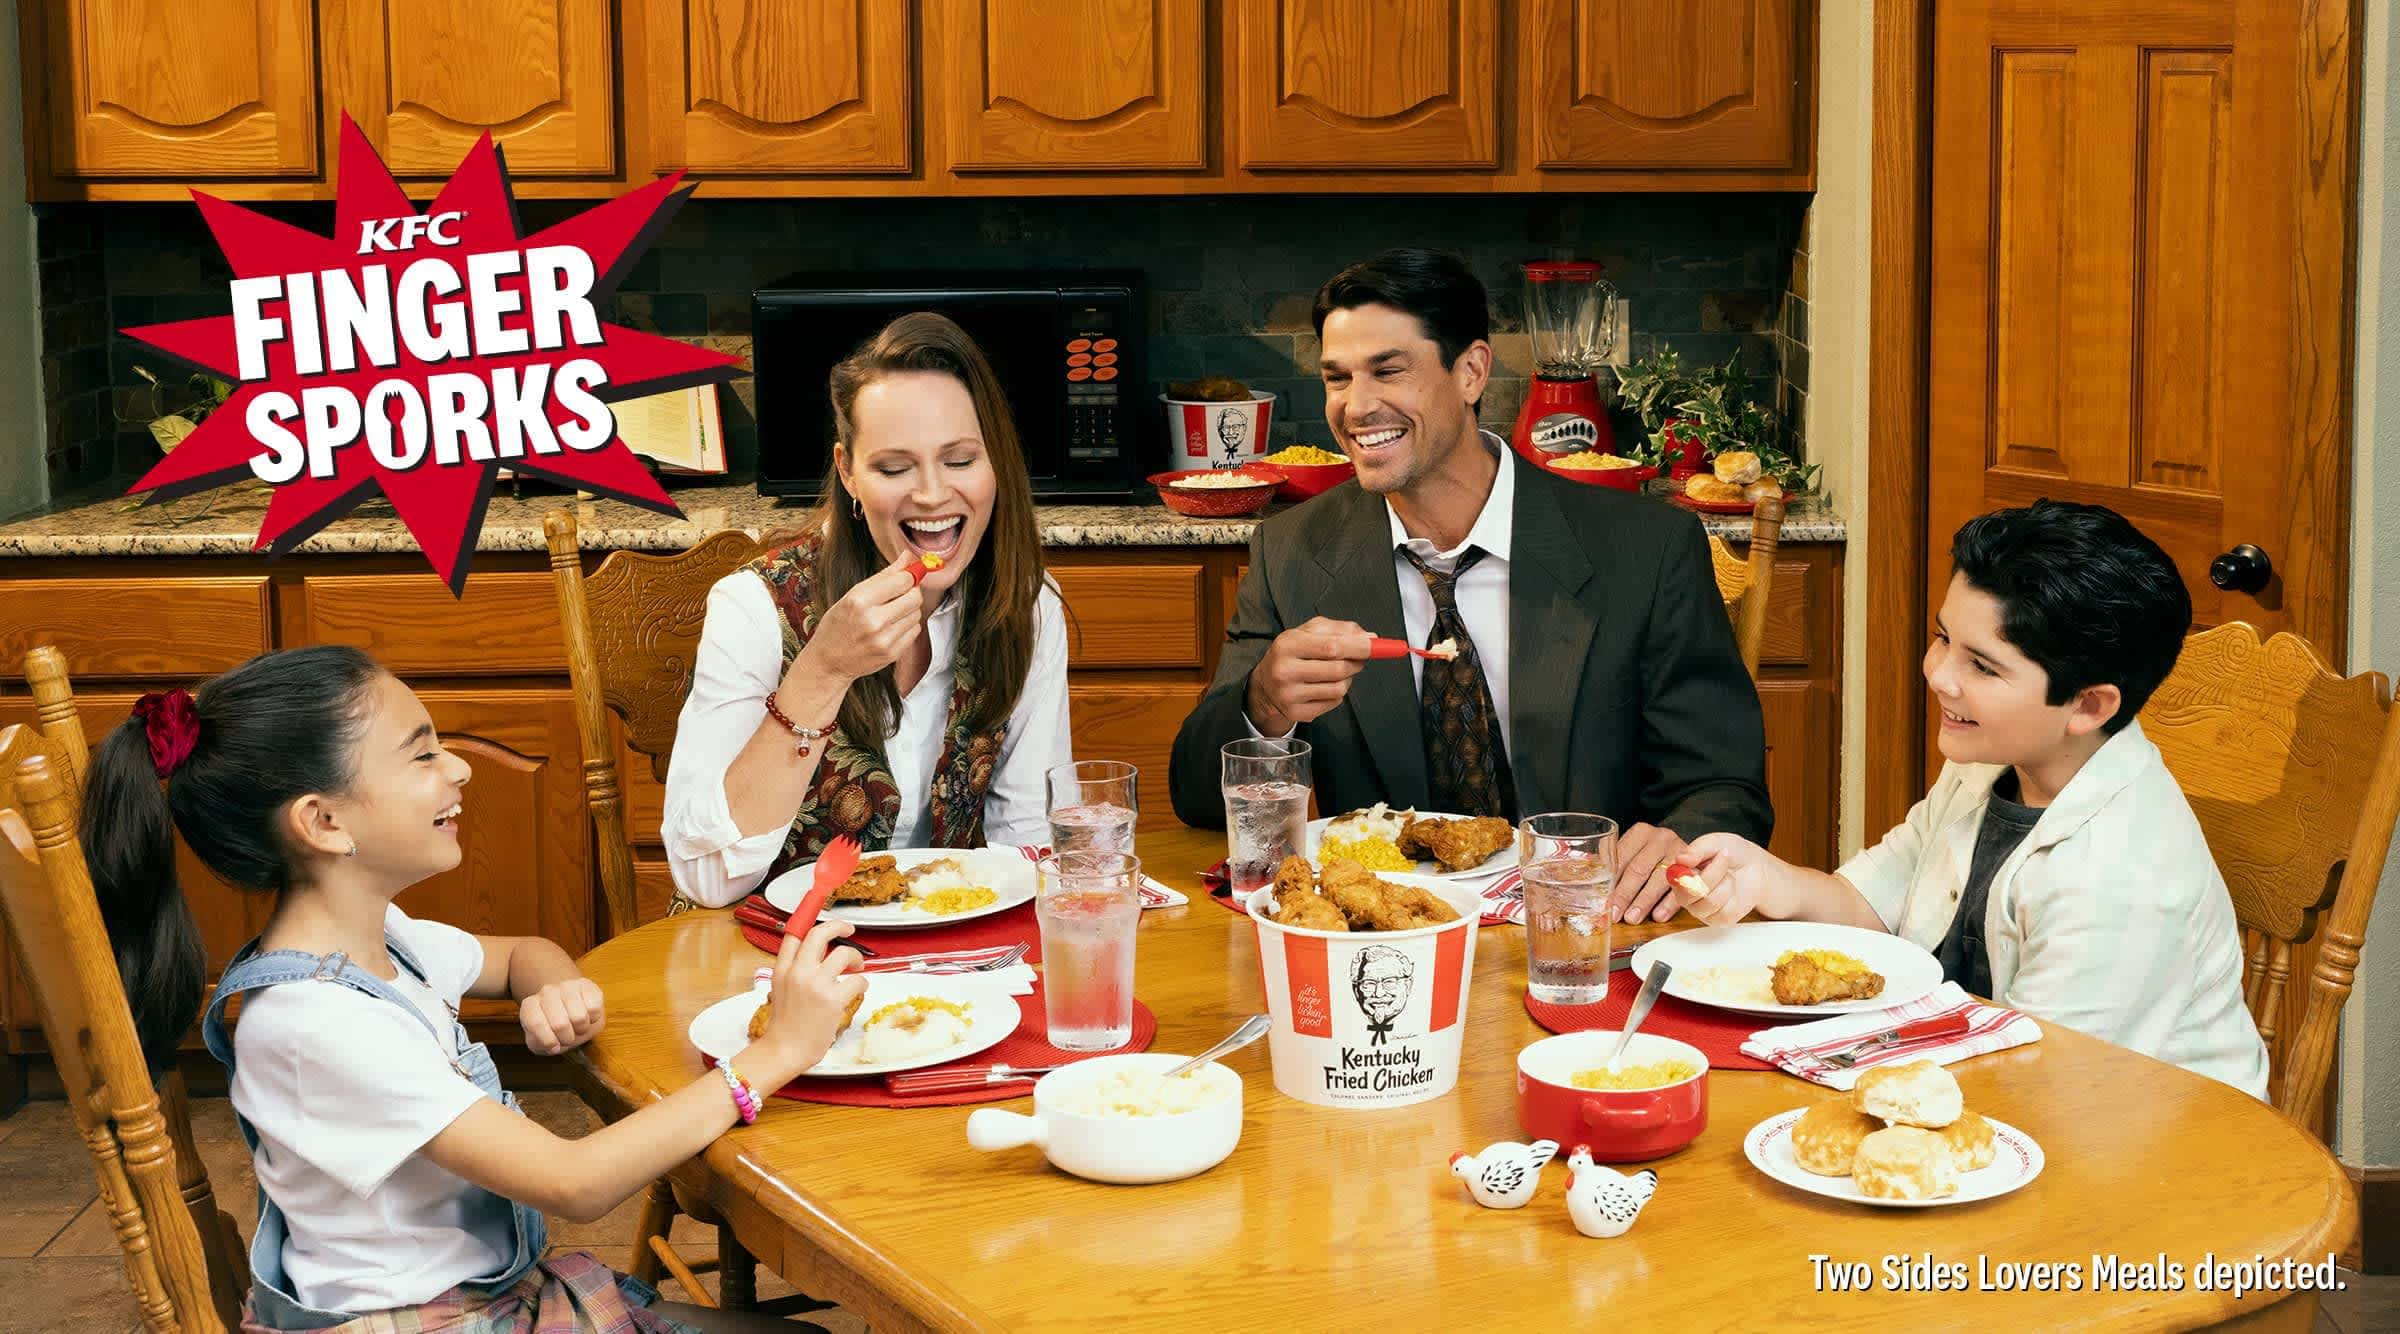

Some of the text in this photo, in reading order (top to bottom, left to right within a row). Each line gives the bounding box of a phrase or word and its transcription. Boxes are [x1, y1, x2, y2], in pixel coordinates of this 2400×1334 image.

[1342, 1045, 1420, 1070] Kentucky
[1323, 1066, 1434, 1091] Fried Chicken
